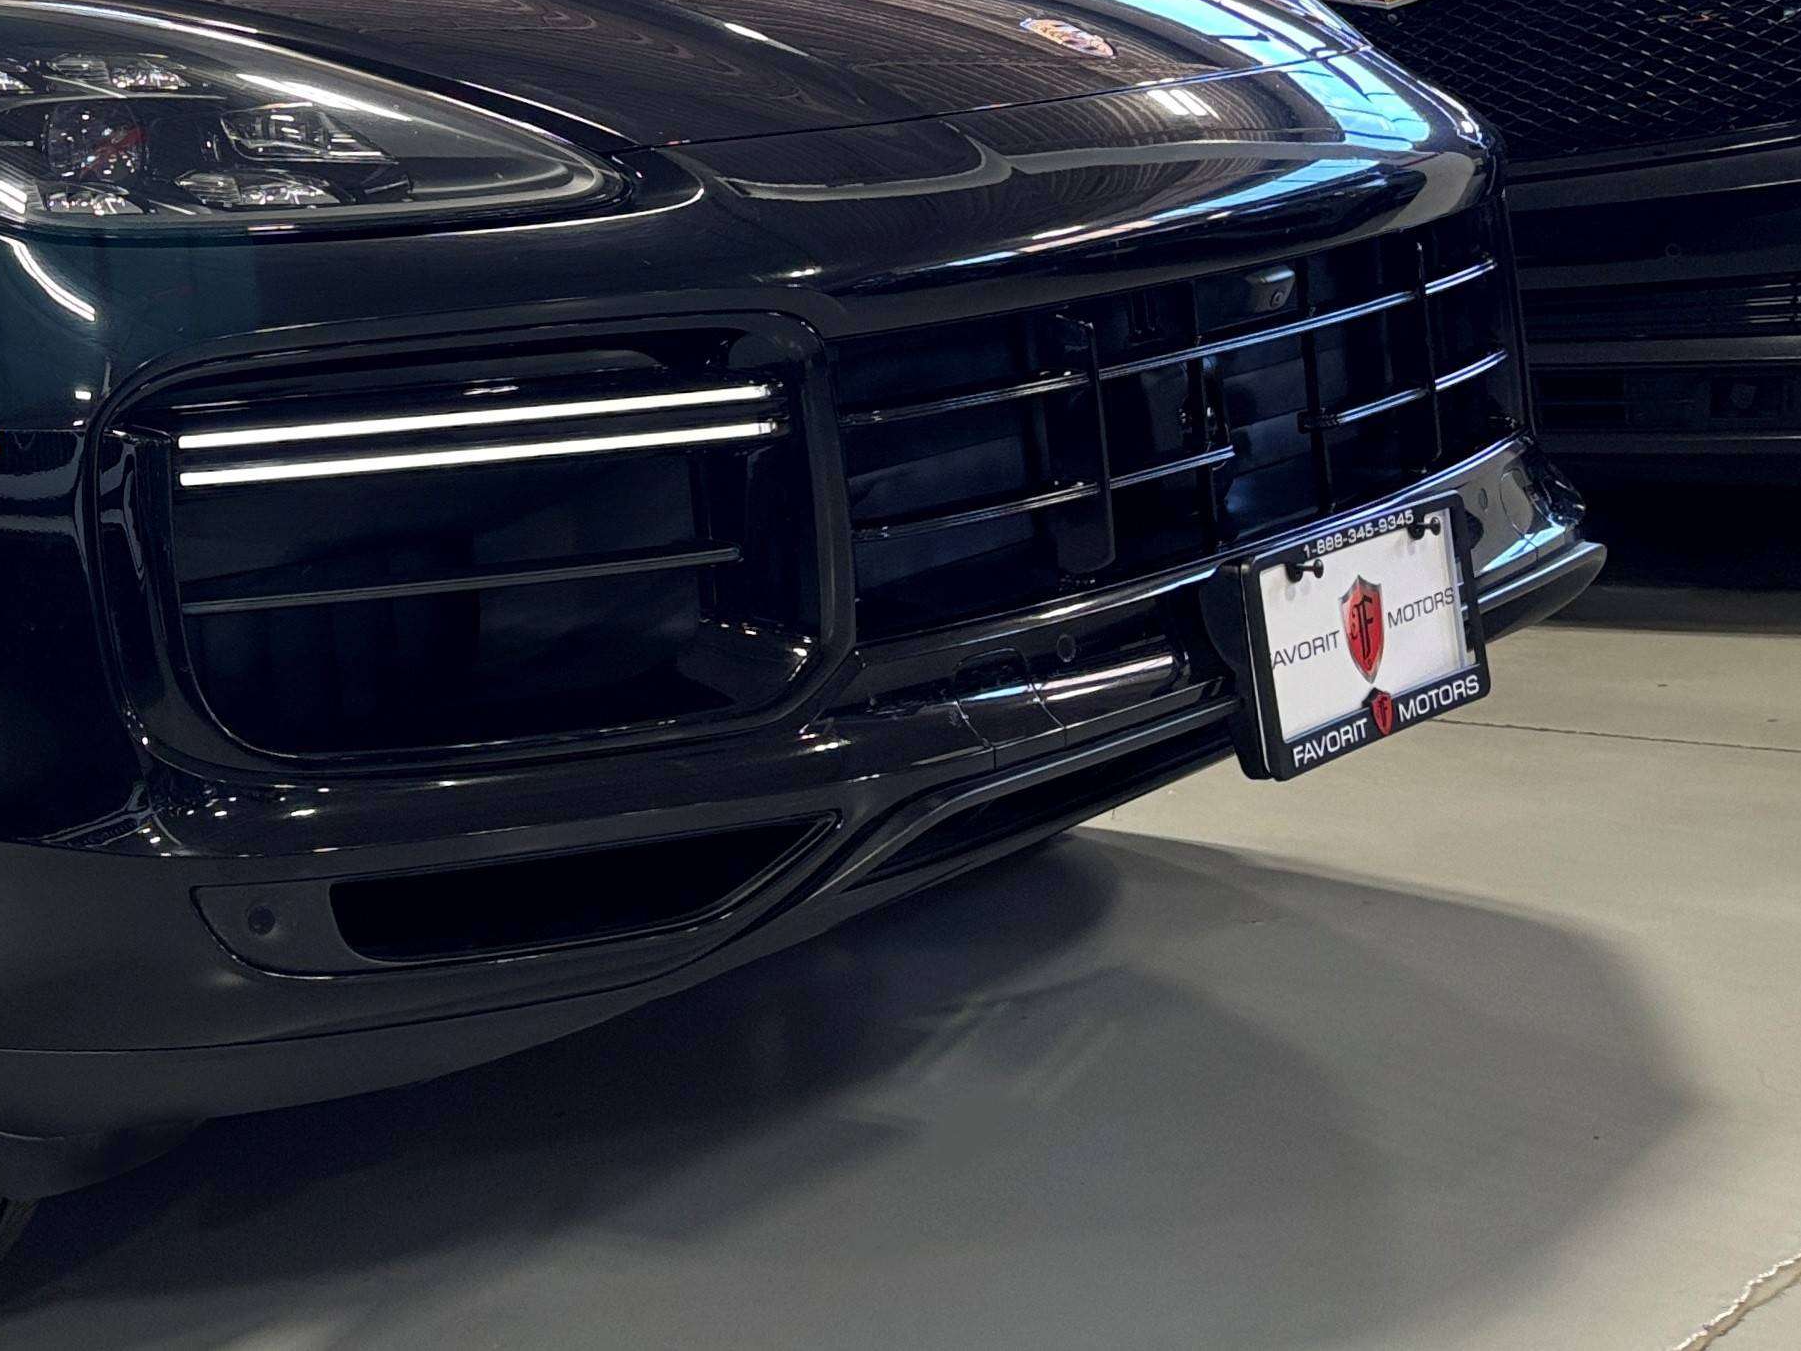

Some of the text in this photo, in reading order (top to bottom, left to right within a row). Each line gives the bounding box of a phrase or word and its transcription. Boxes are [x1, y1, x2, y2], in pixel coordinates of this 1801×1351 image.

[1272, 587, 1455, 669] AVORIT MOTORS
[1292, 717, 1368, 768] FAVORIT
[1398, 675, 1480, 723] MOTORS
